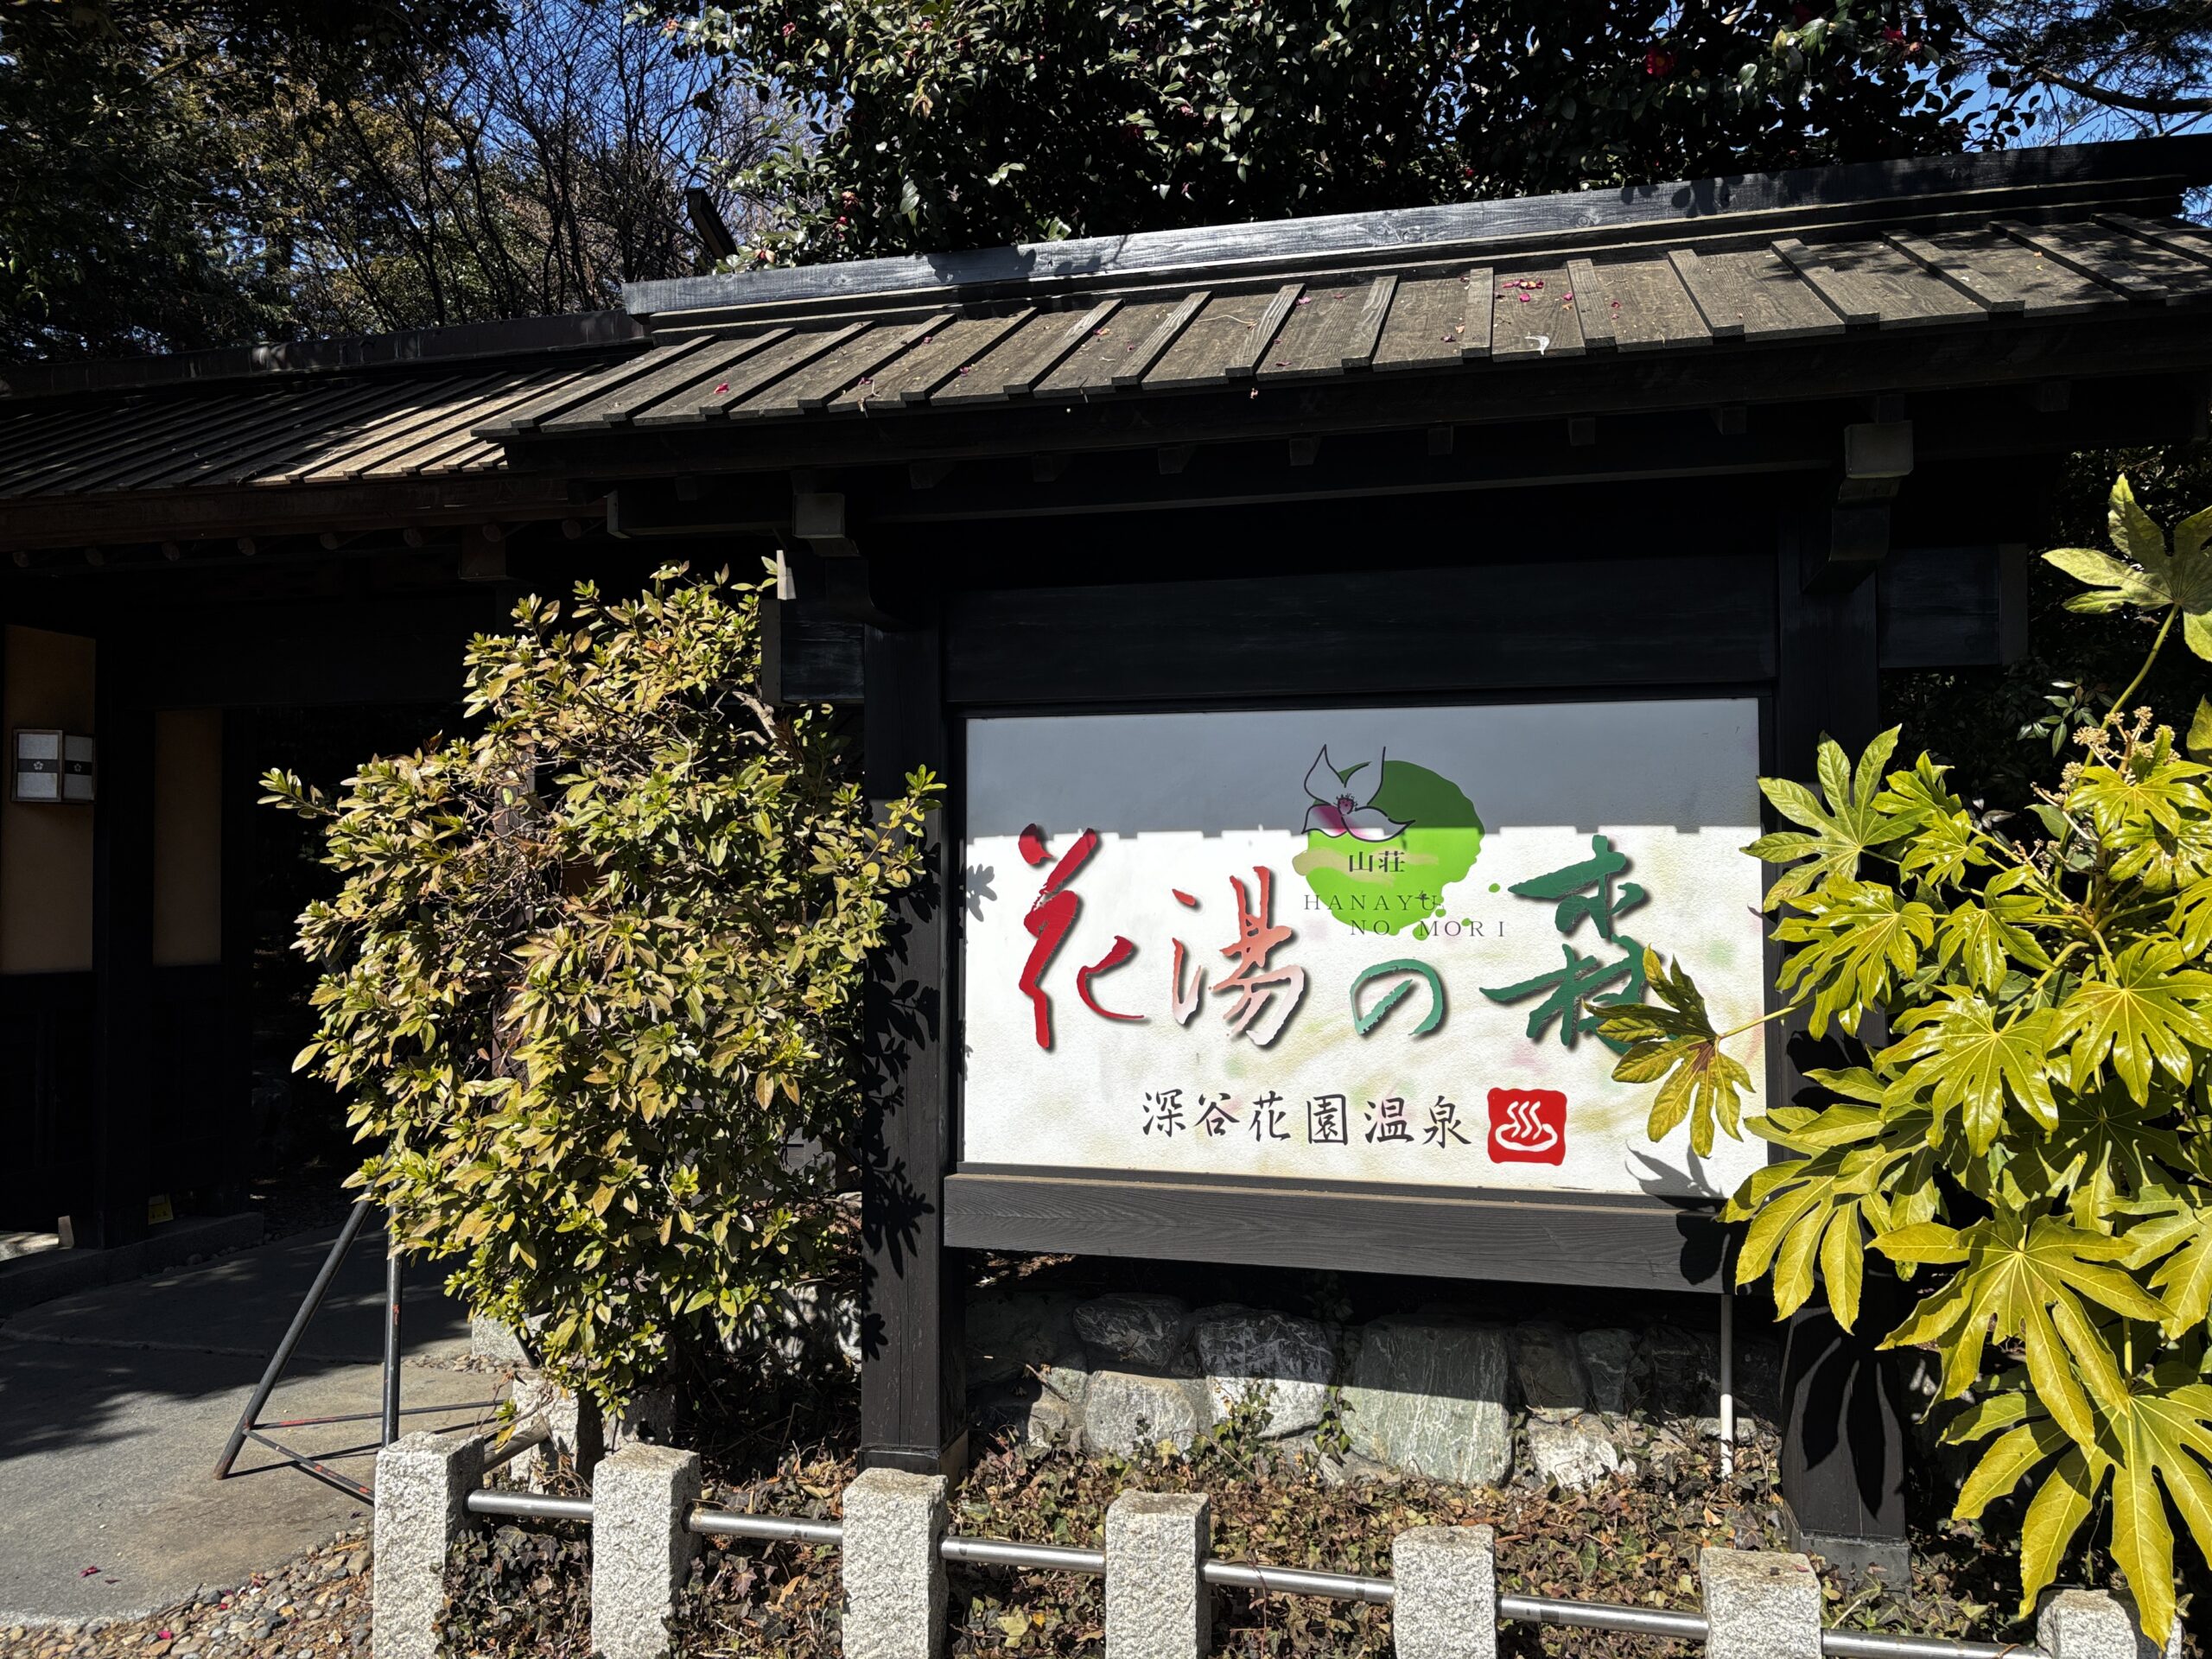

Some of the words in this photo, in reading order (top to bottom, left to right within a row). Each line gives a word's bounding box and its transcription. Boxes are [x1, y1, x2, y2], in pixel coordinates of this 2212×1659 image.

[1349, 850, 1406, 873] 山荘
[1303, 893, 1438, 912] HANAYU
[1018, 823, 1668, 1056] 花湯の森
[1350, 918, 1390, 936] NO
[1418, 920, 1505, 938] MORI
[1141, 1089, 1473, 1149] 深谷花園温泉
